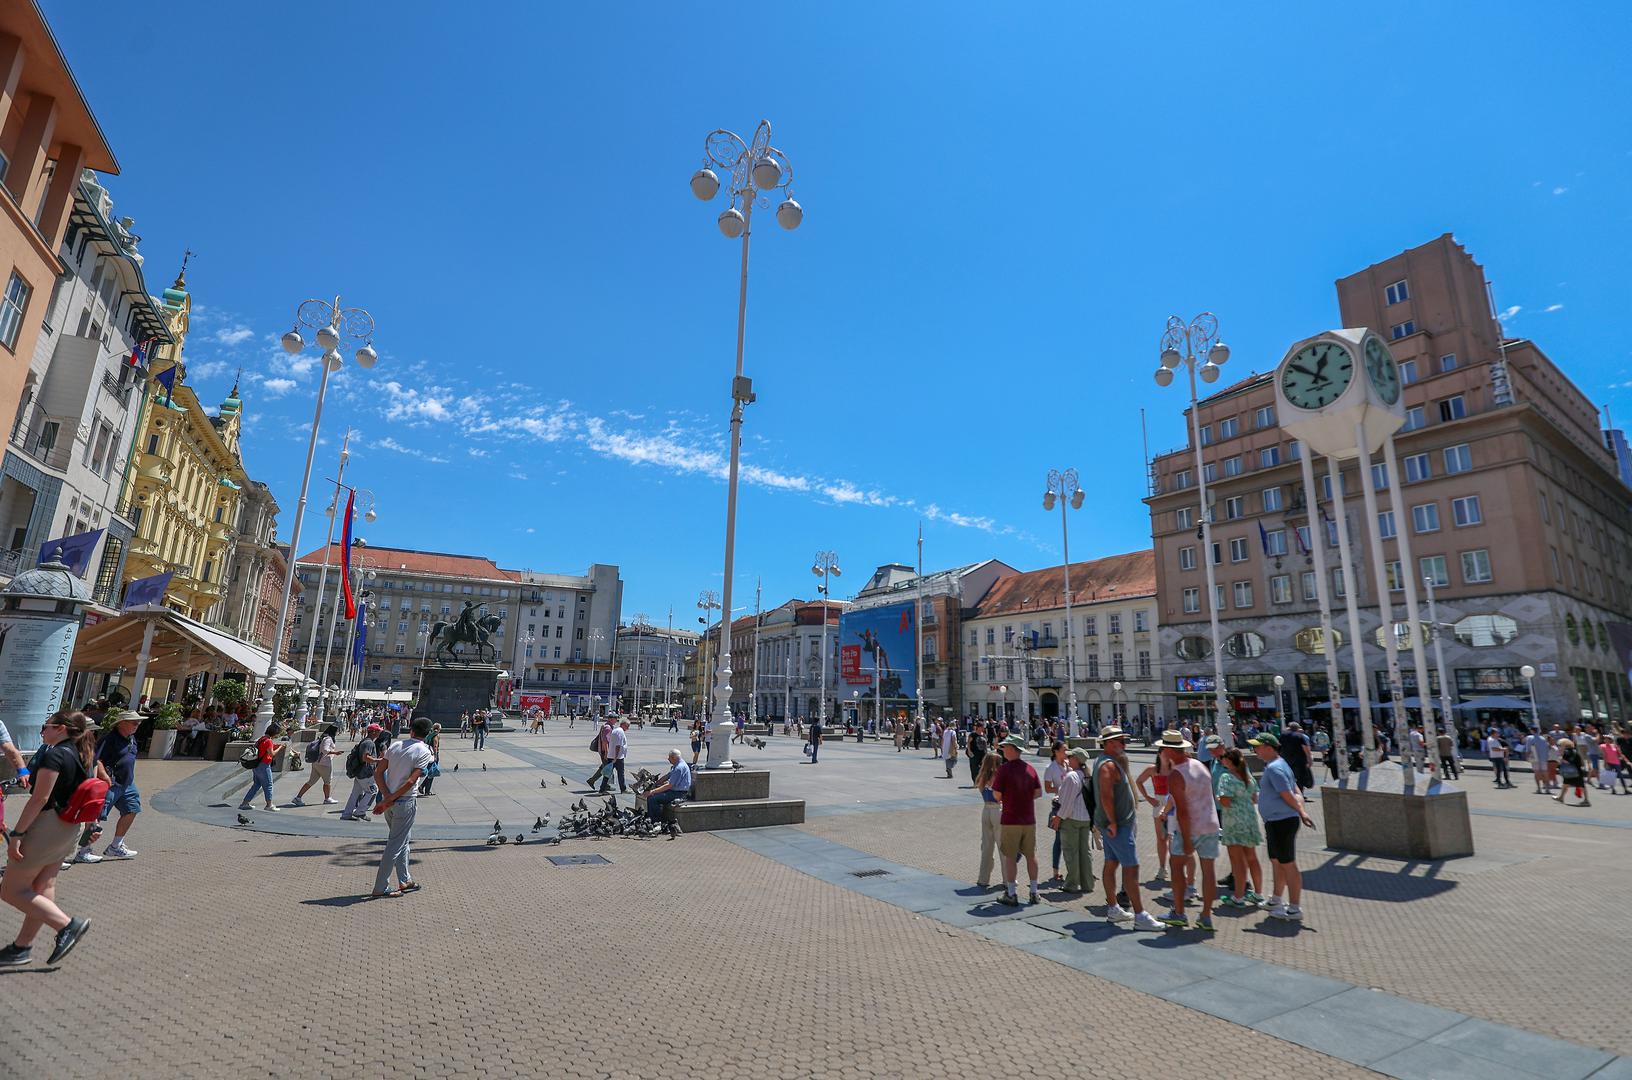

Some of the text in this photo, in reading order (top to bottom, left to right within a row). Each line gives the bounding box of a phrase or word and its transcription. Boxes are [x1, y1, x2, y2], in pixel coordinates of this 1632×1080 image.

[63, 627, 73, 642] 43.
[50, 685, 60, 701] NA
[45, 703, 56, 720] GR
